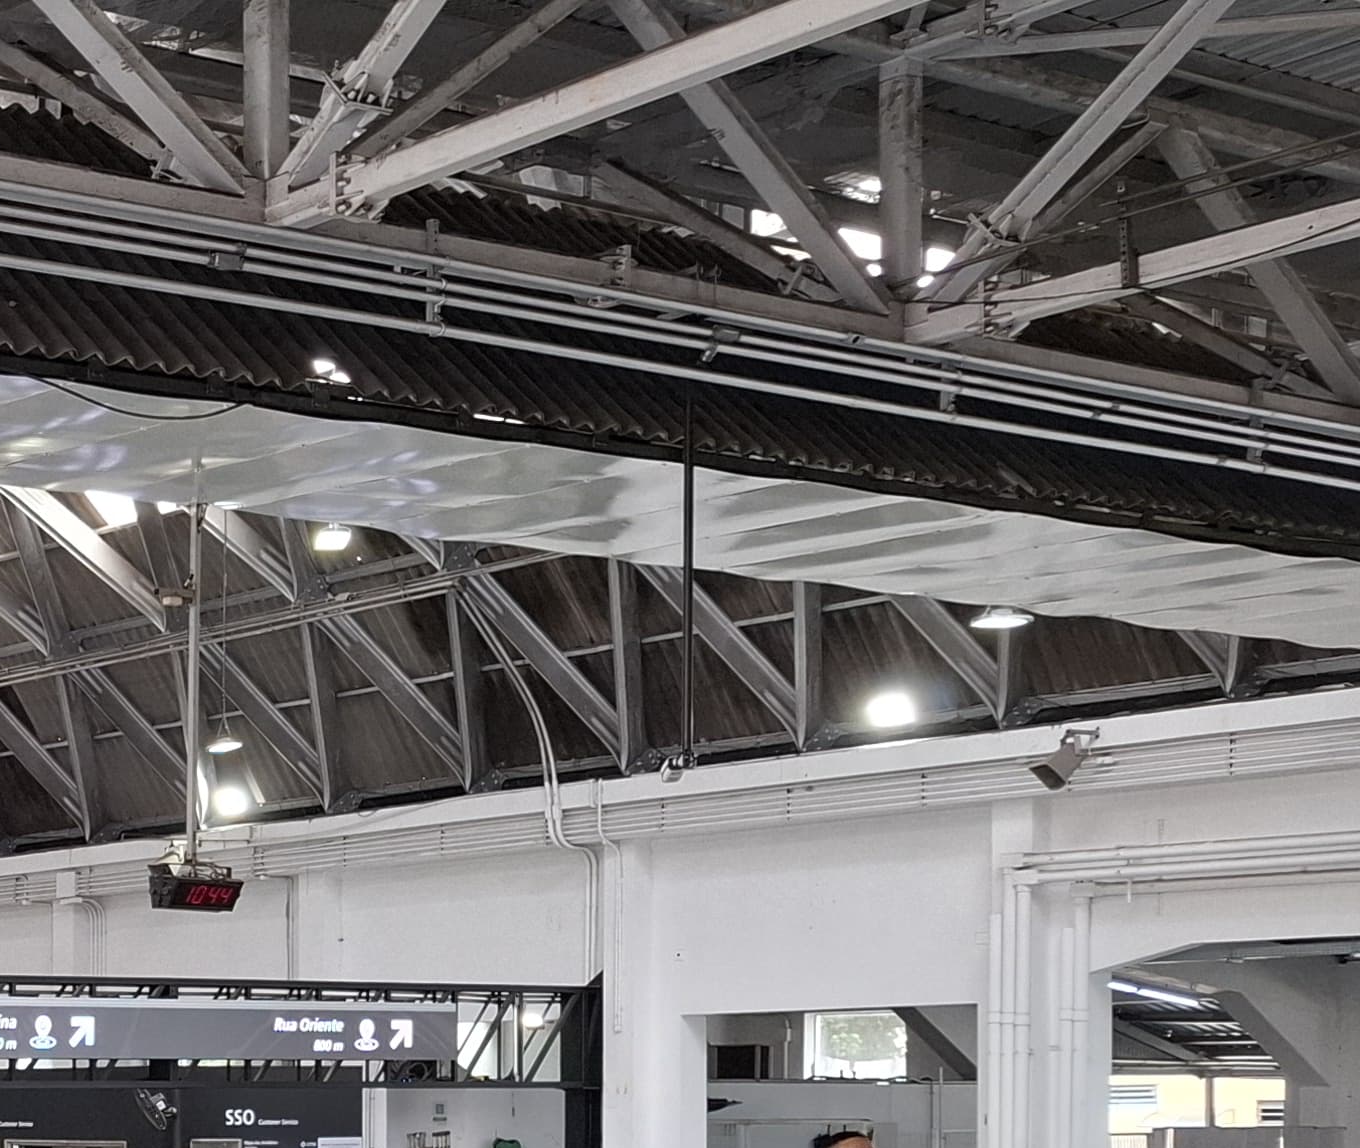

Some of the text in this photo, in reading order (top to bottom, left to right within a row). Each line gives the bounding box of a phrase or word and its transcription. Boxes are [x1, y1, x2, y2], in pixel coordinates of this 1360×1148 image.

[273, 1017, 344, 1032] Rua Oriente
[6, 1040, 17, 1050] m
[333, 1041, 344, 1052] m
[225, 1109, 255, 1125] SSO
